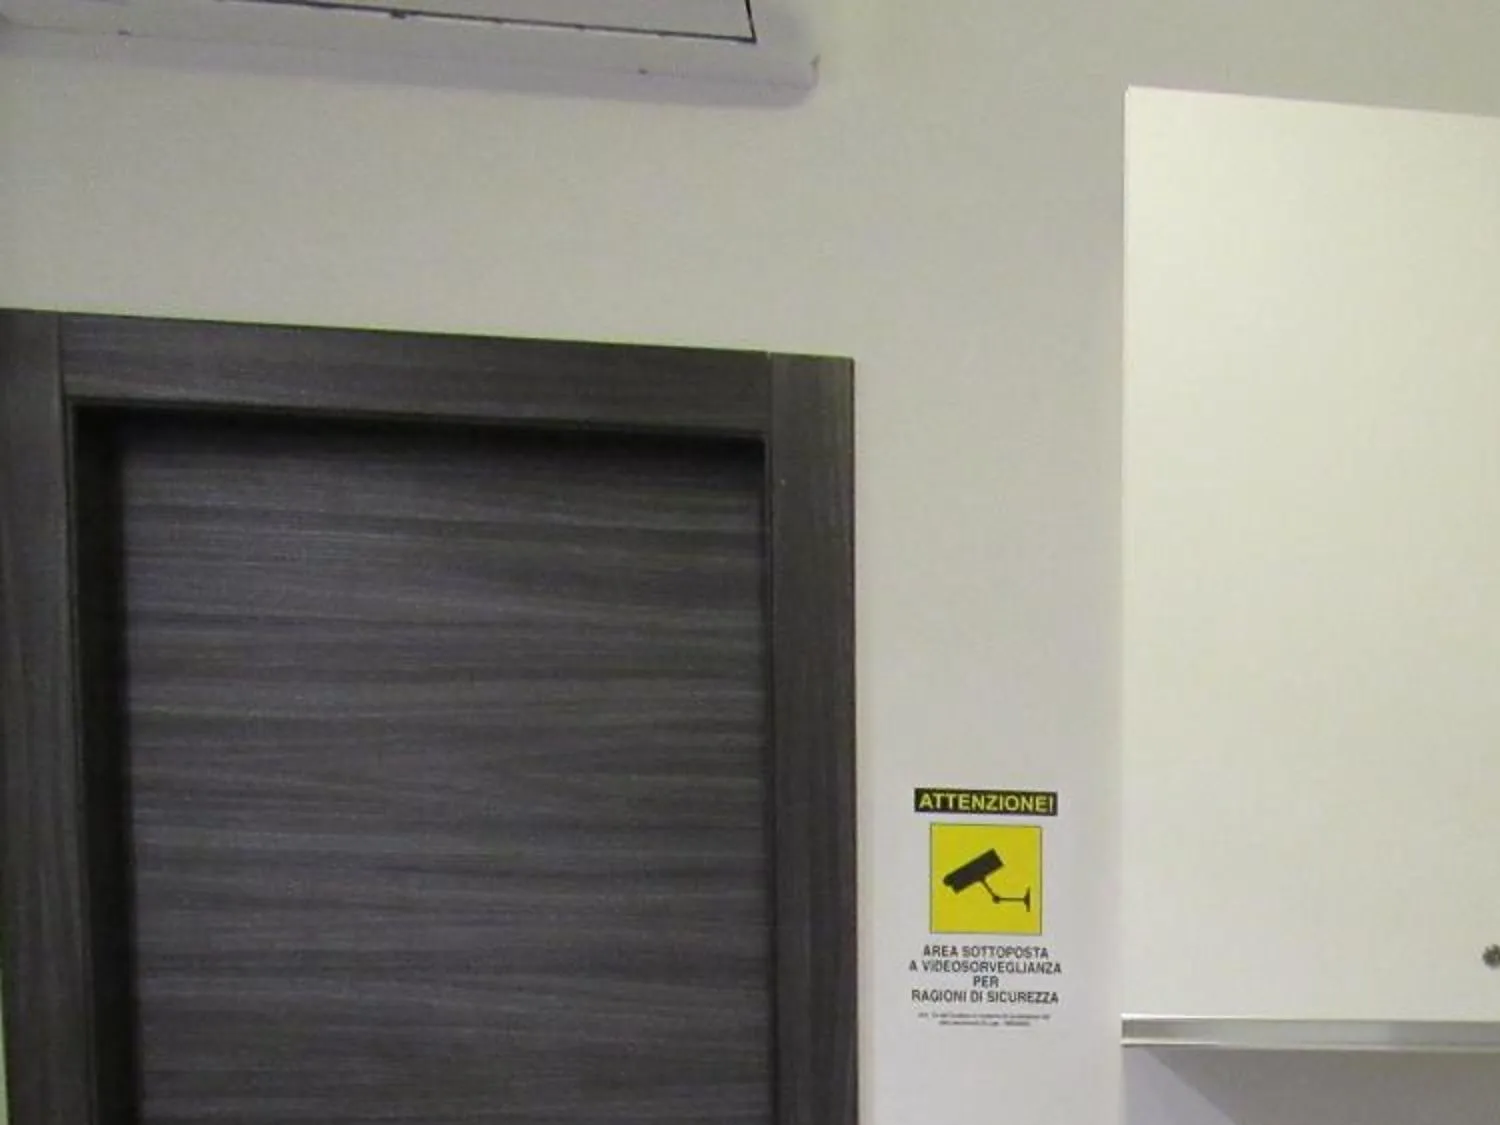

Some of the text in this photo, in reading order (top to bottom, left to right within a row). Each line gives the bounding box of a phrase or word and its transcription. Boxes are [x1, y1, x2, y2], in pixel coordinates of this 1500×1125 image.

[918, 792, 1054, 814] ATTENZIONE!
[923, 944, 1049, 960] AREA SOTTOPOSTA
[909, 959, 1062, 974] A VIDEOSORVEGLIANZA
[973, 975, 999, 988] PER
[911, 989, 1060, 1005] RAGIONI DI SICUREZZA
